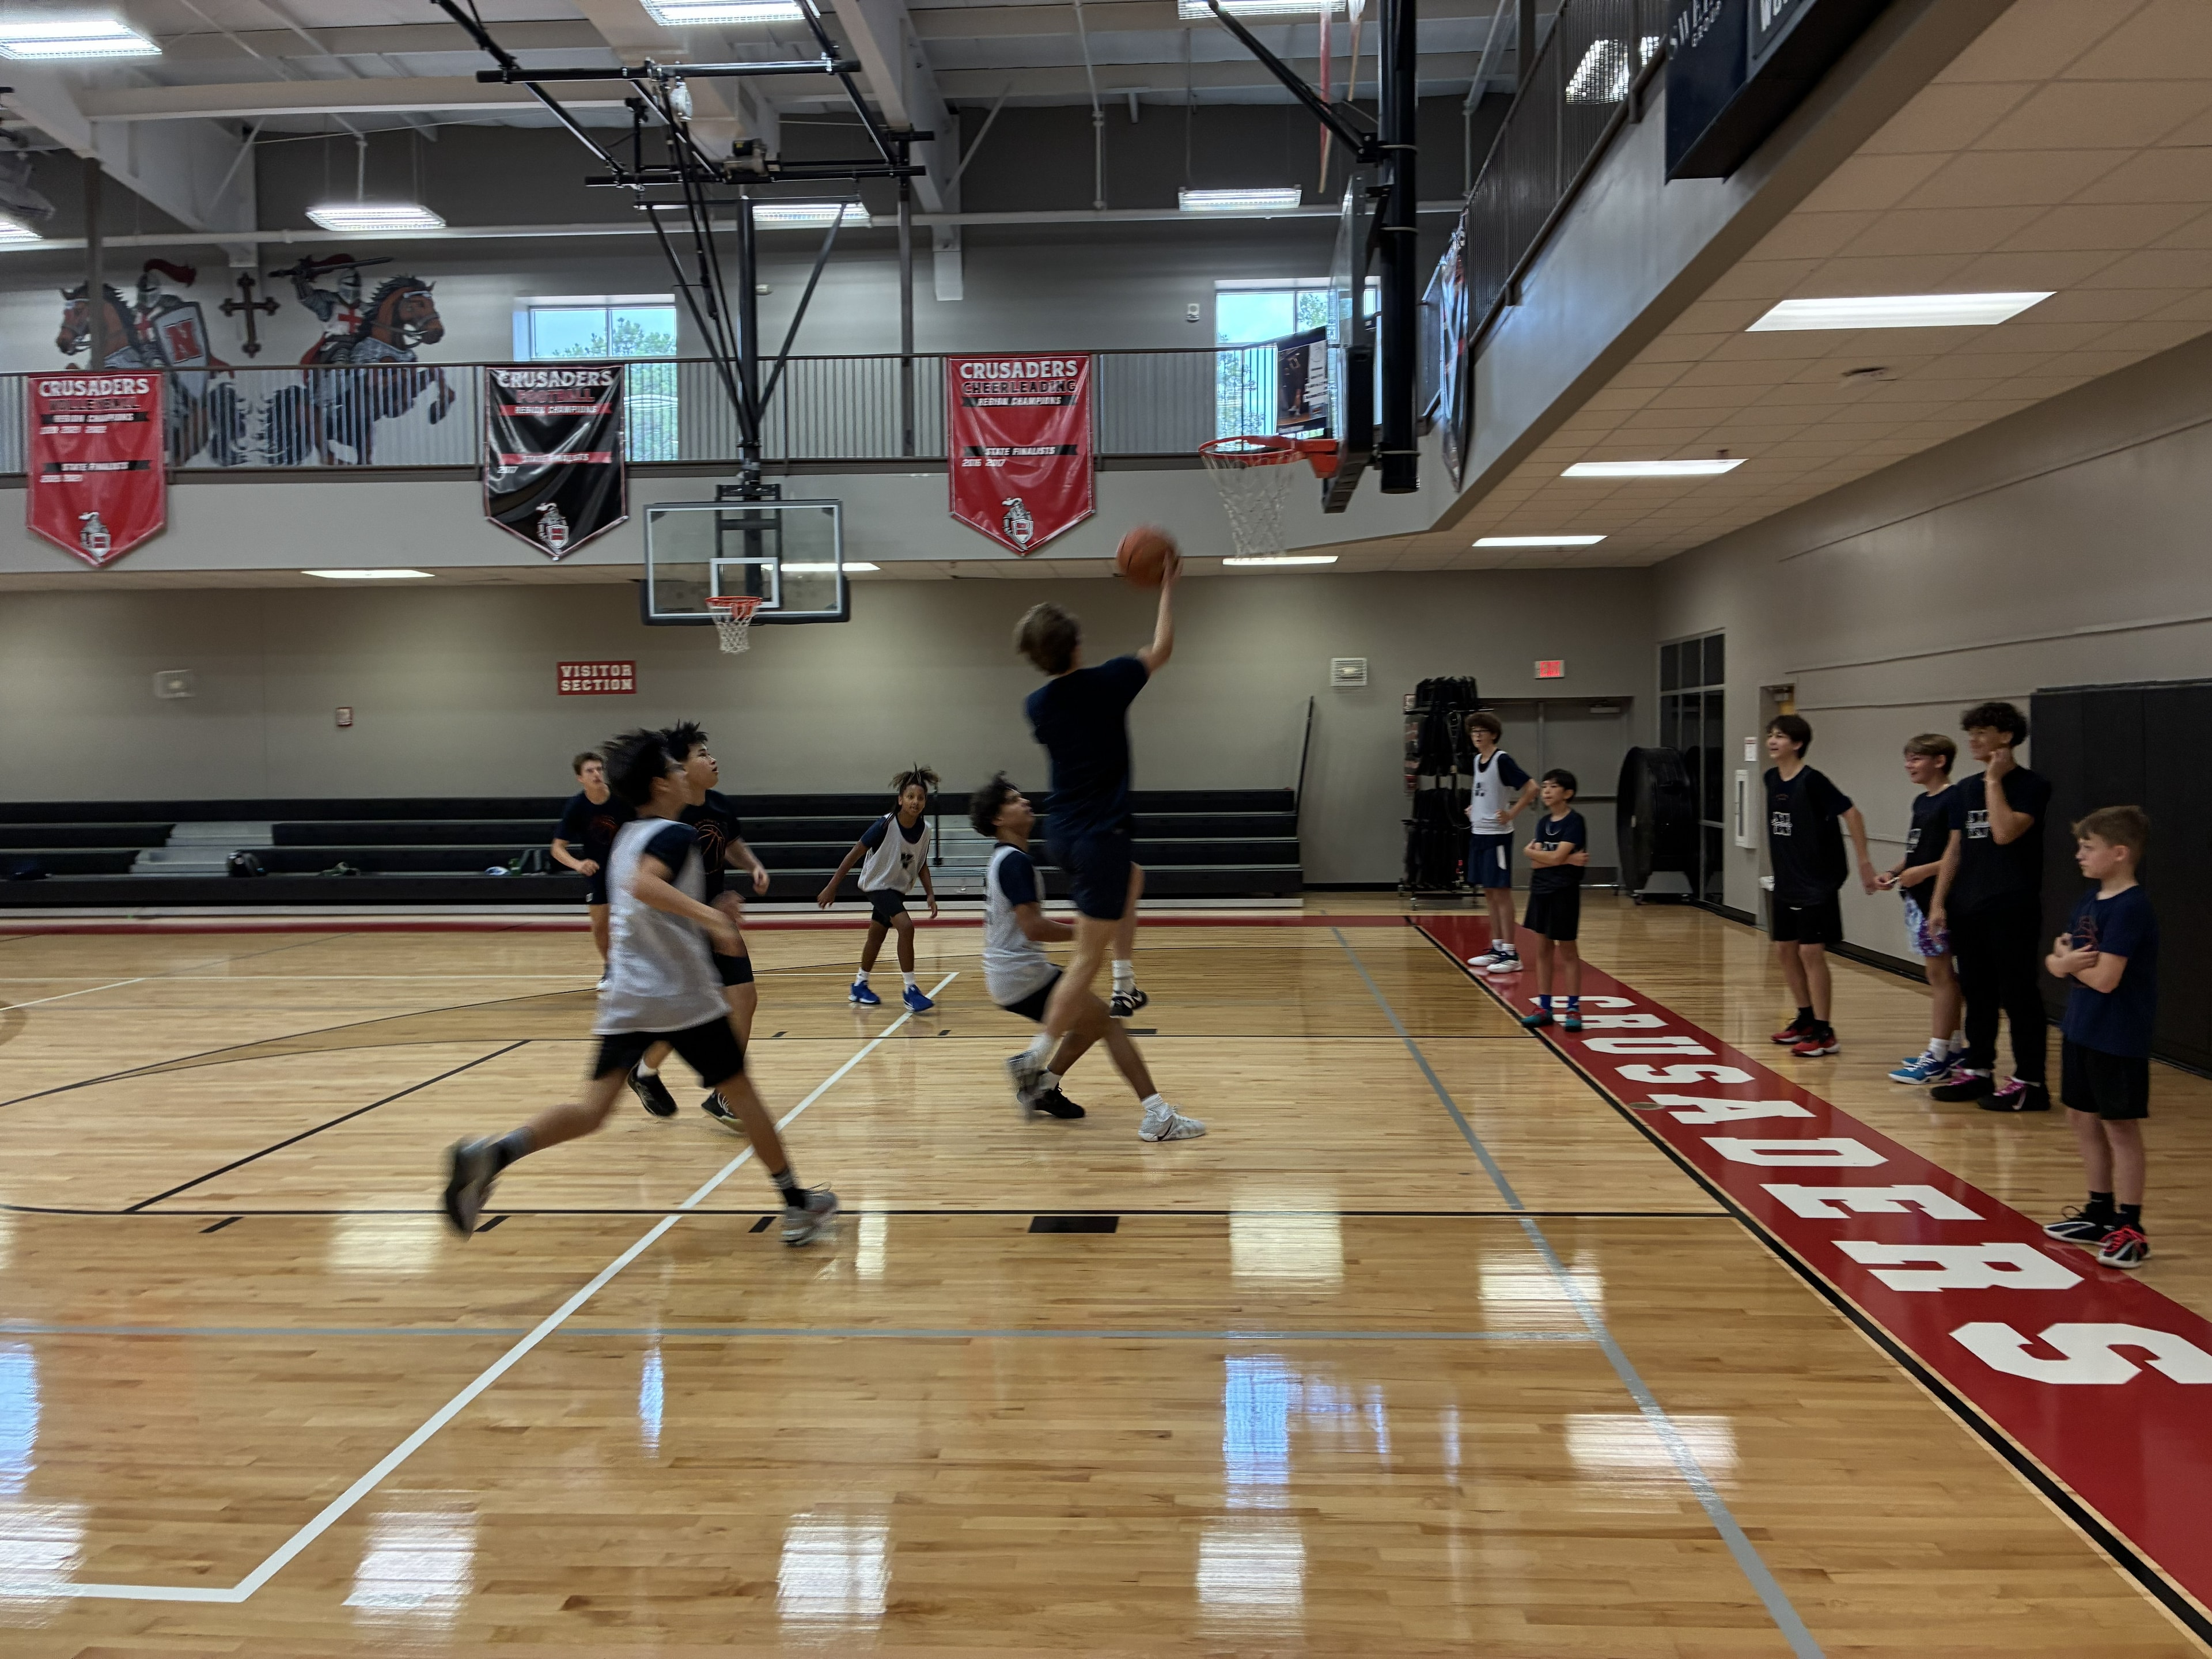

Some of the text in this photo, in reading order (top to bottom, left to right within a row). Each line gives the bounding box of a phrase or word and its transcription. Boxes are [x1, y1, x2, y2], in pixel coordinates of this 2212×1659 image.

[497, 370, 613, 388] CRUSADERS
[960, 361, 1078, 379] CRUSADERS
[39, 378, 150, 396] CRUSADERS
[962, 380, 1077, 395] CHEERLEADING
[560, 664, 632, 677] VISITOR
[560, 678, 633, 691] SECTION
[1528, 996, 2212, 1384] CRUSADERS
